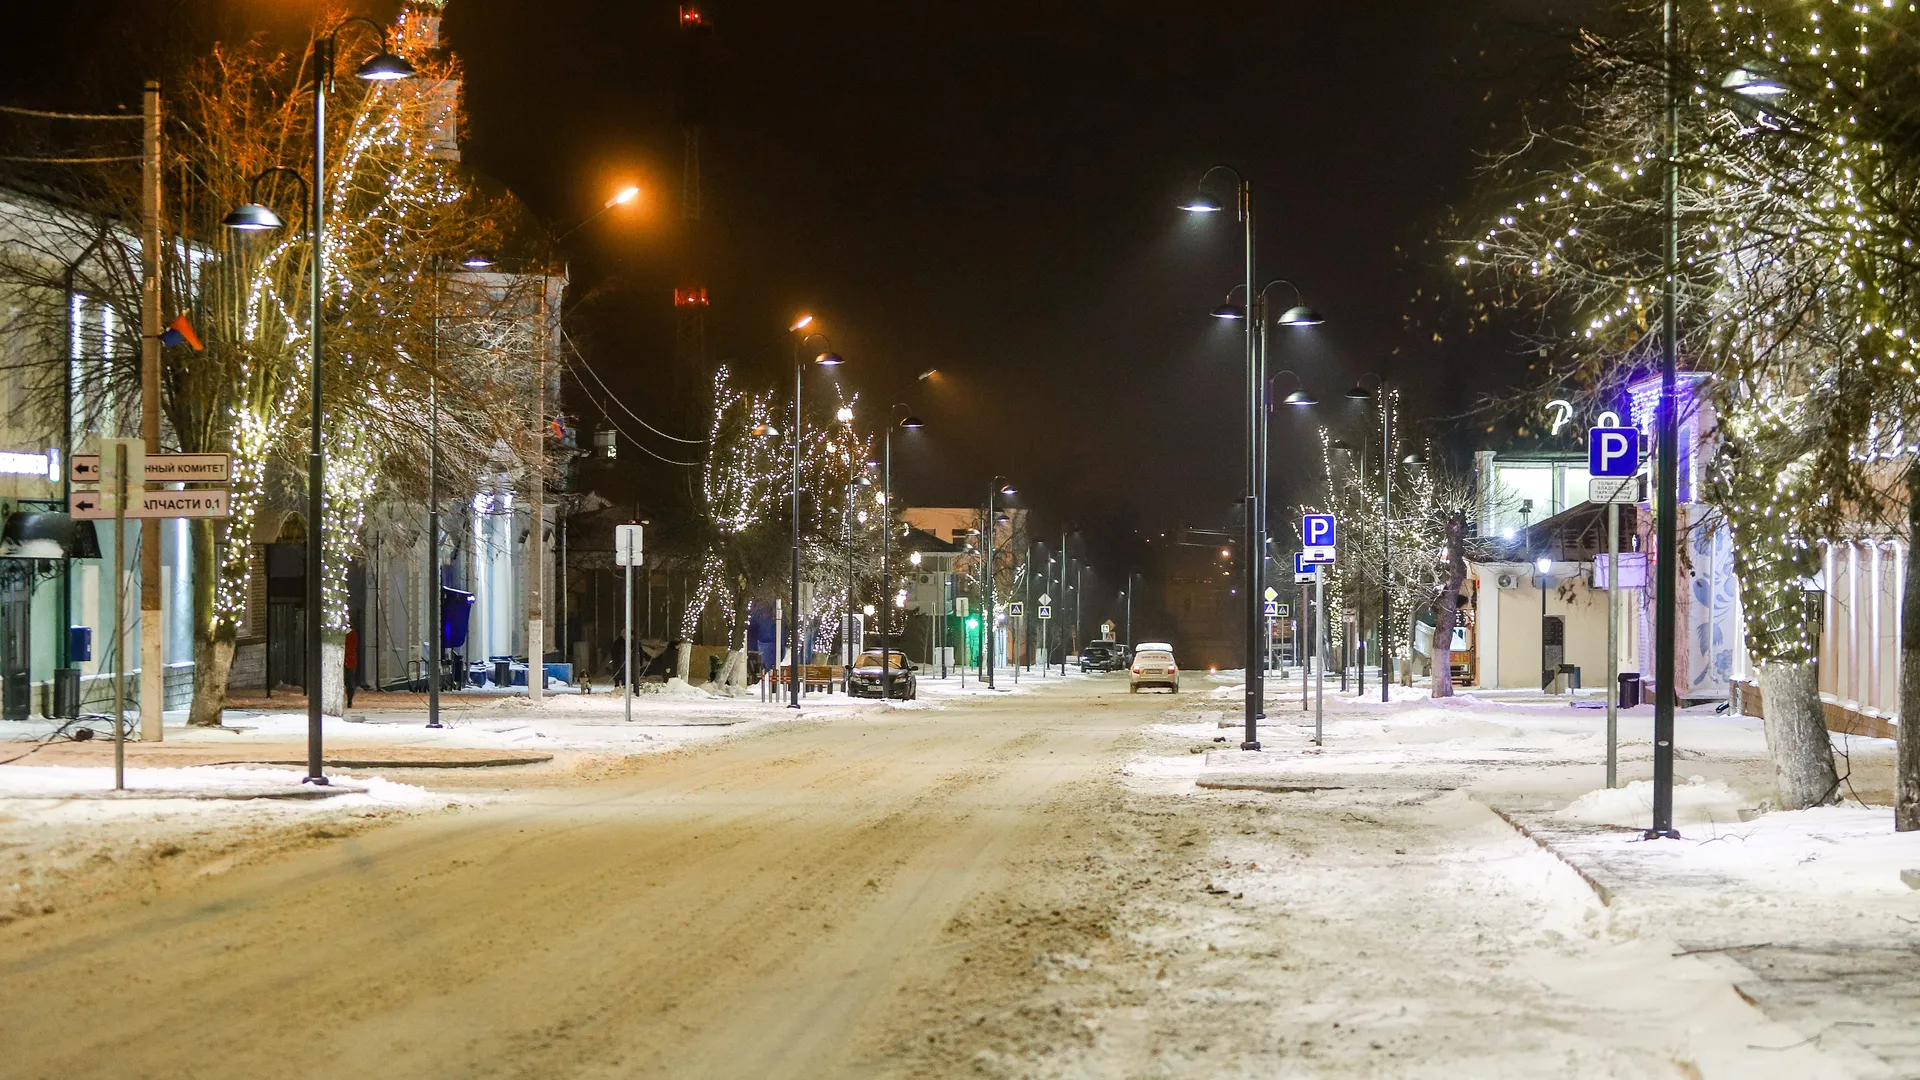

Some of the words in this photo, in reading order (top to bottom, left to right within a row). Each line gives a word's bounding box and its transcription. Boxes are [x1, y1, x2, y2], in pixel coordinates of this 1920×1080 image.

[1601, 433, 1628, 471] P
[178, 464, 224, 473] КОМИТЕТ
[1311, 519, 1329, 543] P
